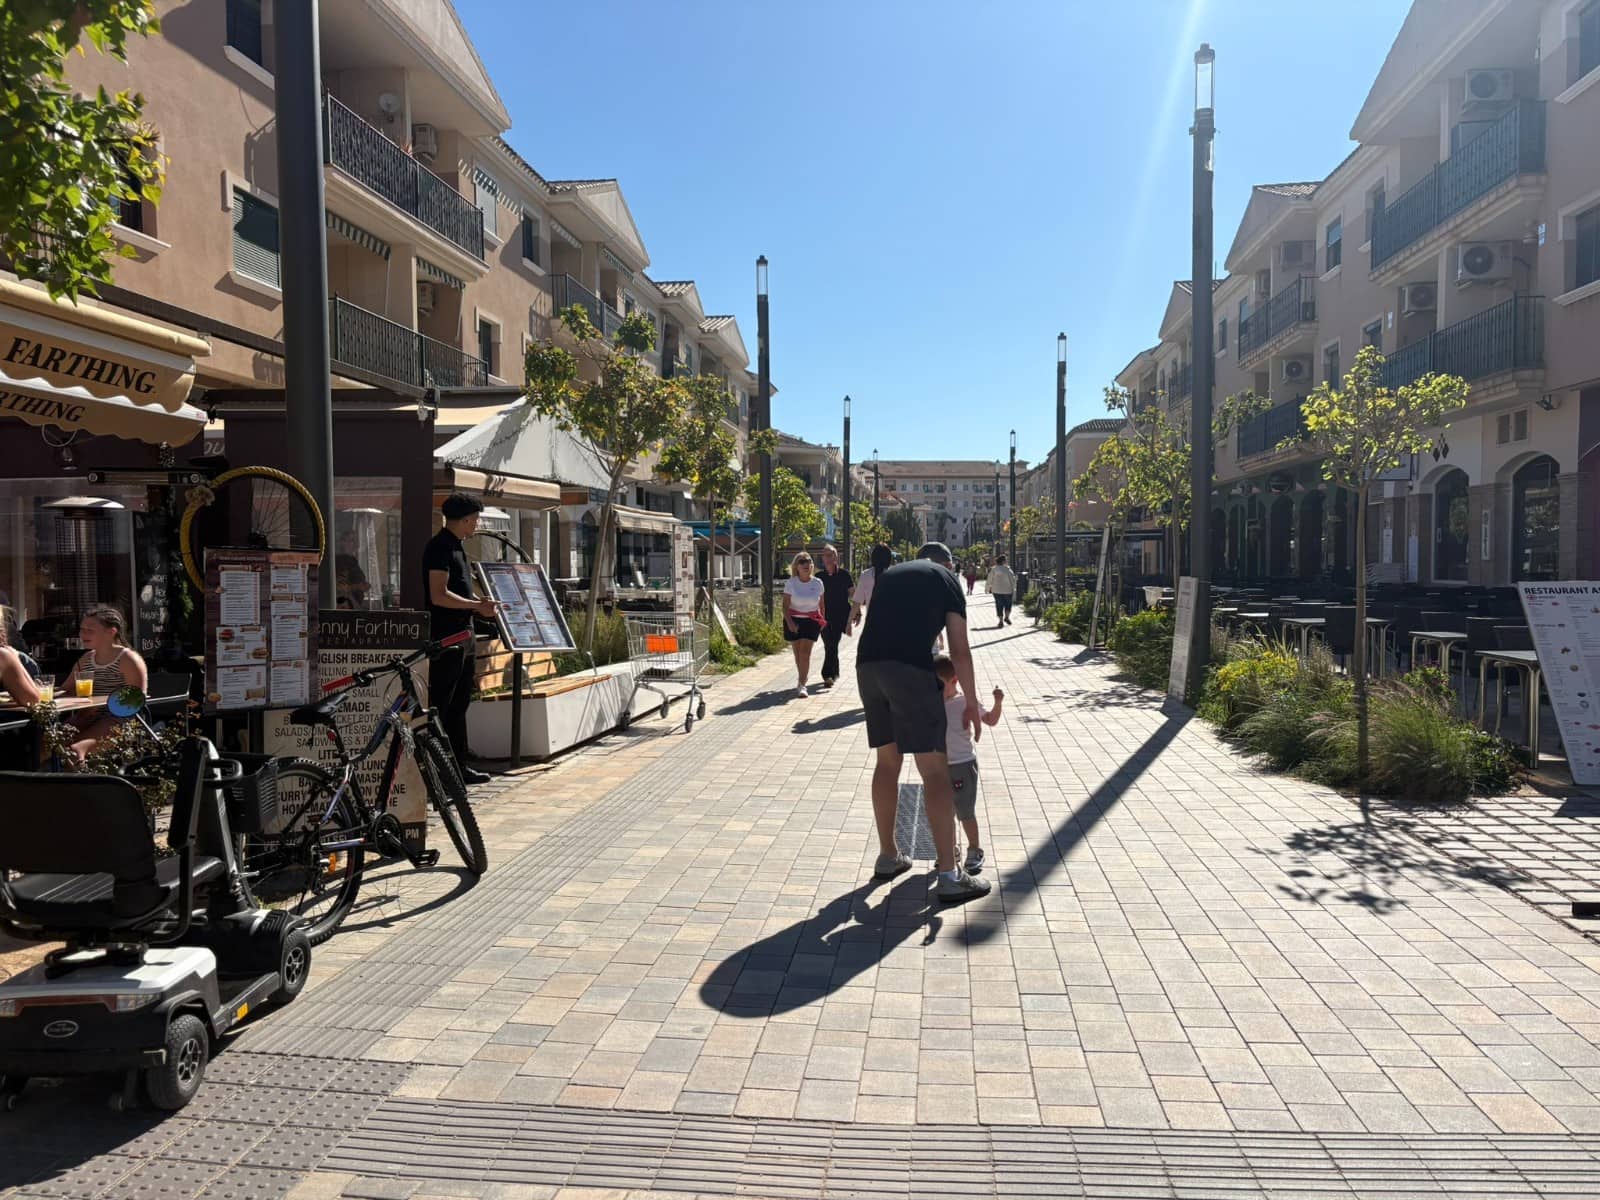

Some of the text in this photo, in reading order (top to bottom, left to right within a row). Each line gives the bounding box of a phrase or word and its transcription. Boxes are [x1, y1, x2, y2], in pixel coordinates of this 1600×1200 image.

[3, 337, 157, 394] FARTHING
[1524, 587, 1589, 595] RESTAURANT
[318, 621, 350, 640] nny
[355, 617, 420, 641] Farthing
[352, 688, 380, 698] SMALL
[361, 760, 386, 771] LUNC
[405, 828, 420, 840] PM
